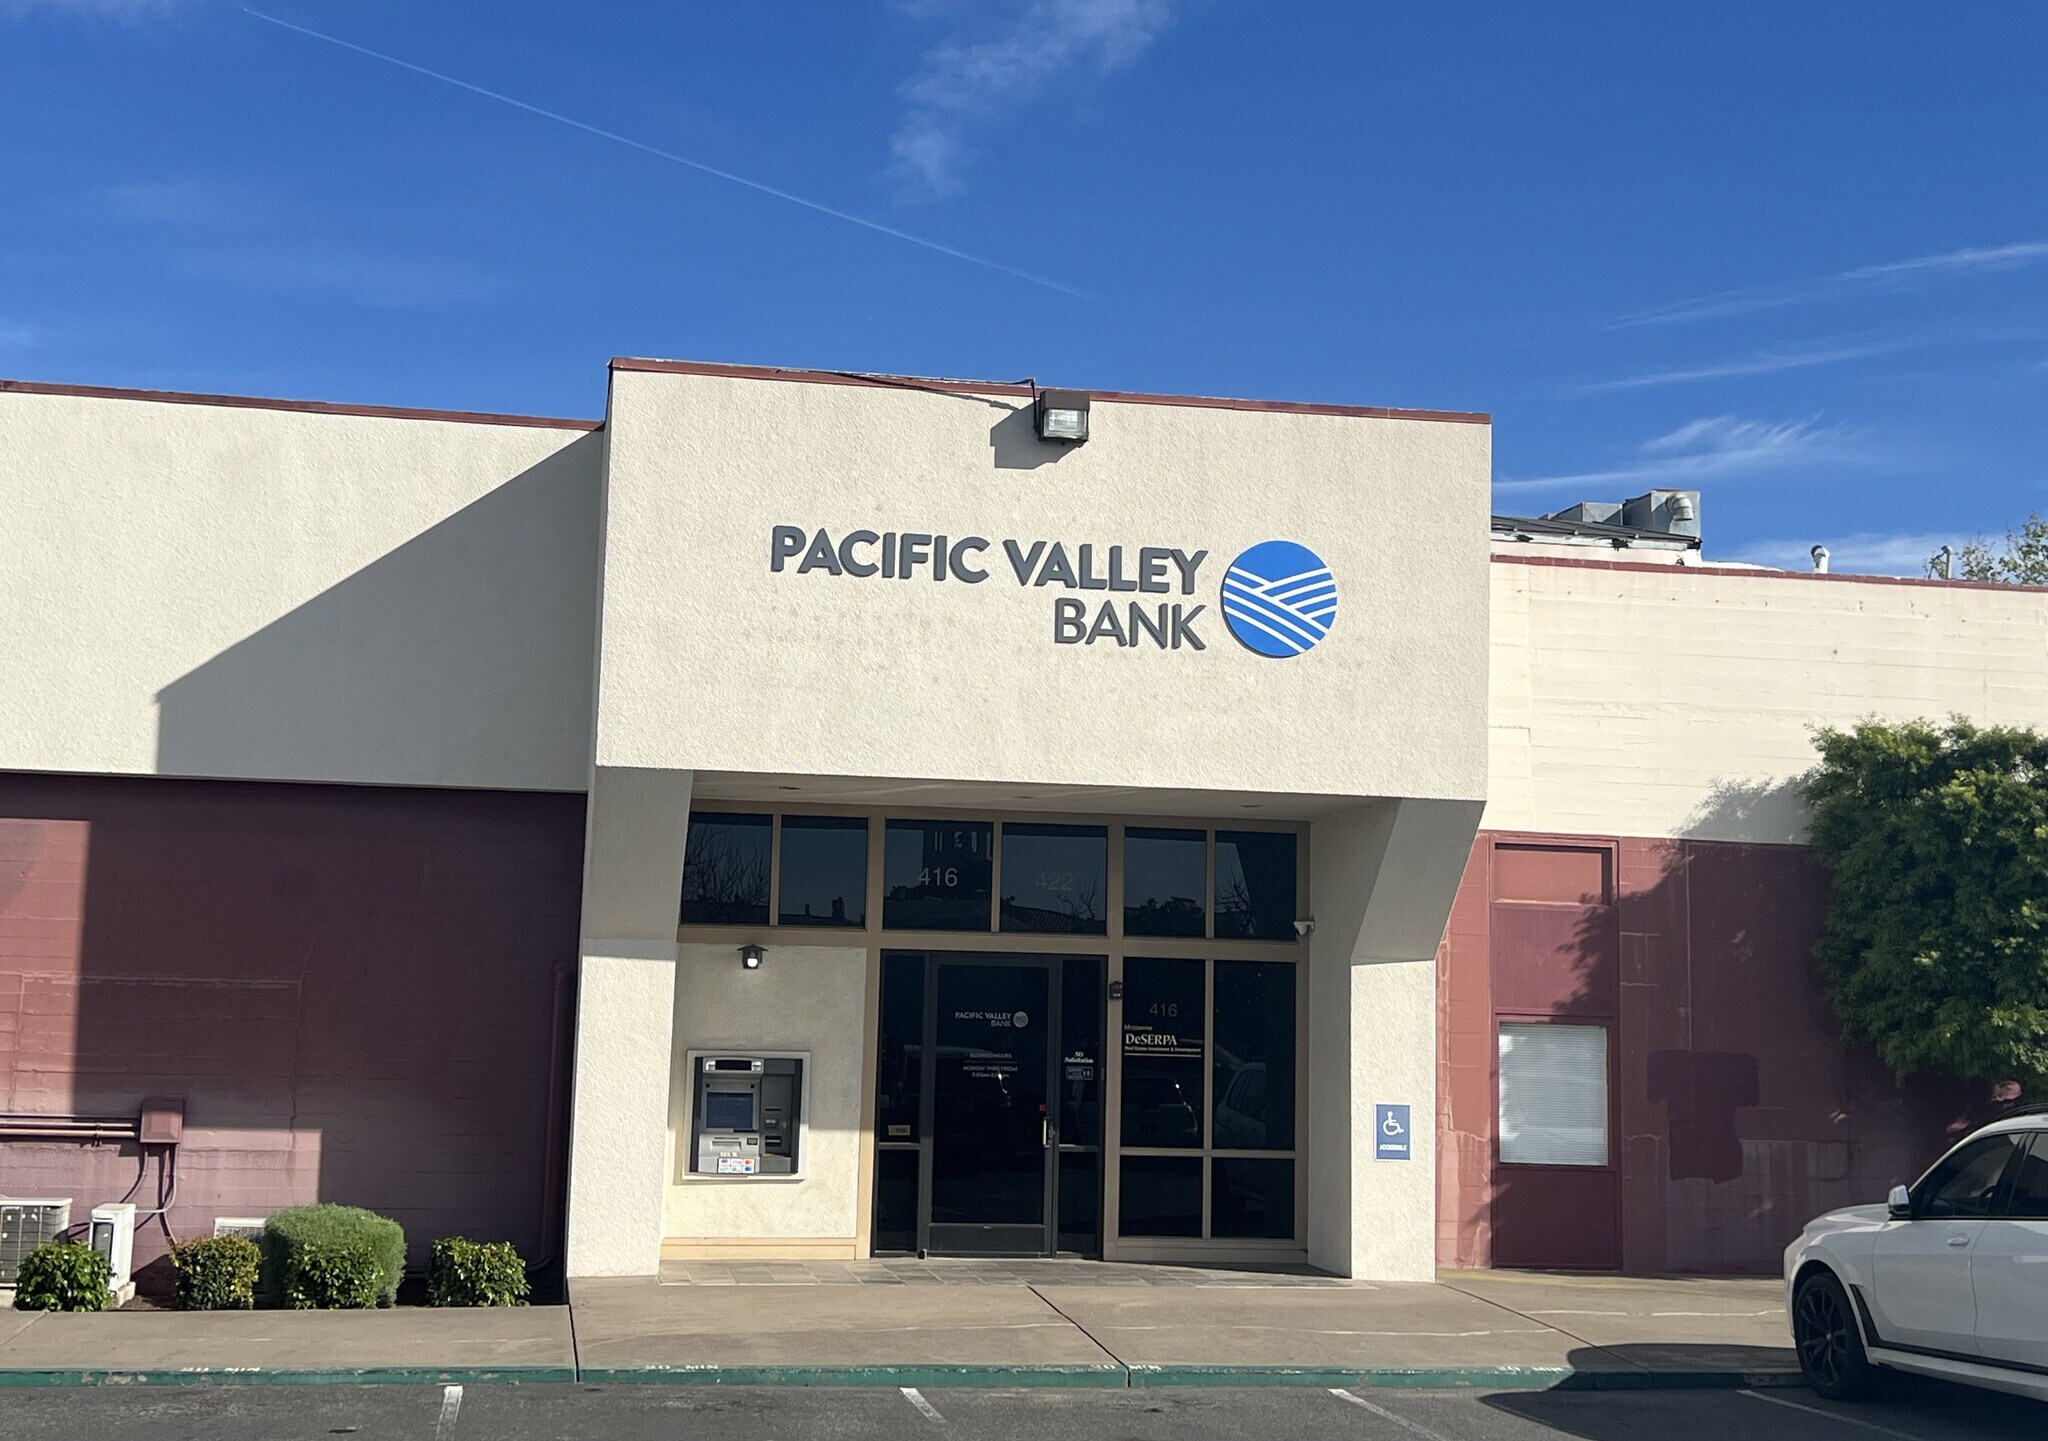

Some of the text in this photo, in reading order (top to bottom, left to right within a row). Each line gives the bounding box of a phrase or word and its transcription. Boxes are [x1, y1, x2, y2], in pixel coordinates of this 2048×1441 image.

[771, 525, 1209, 595] PACIFIC VALLEY
[1054, 597, 1207, 651] BANK
[918, 867, 958, 887] 416
[1035, 872, 1074, 891] 422
[985, 1012, 1012, 1020] VALLEY
[1149, 1003, 1178, 1017] 416
[1125, 1033, 1178, 1046] DeSERPA
